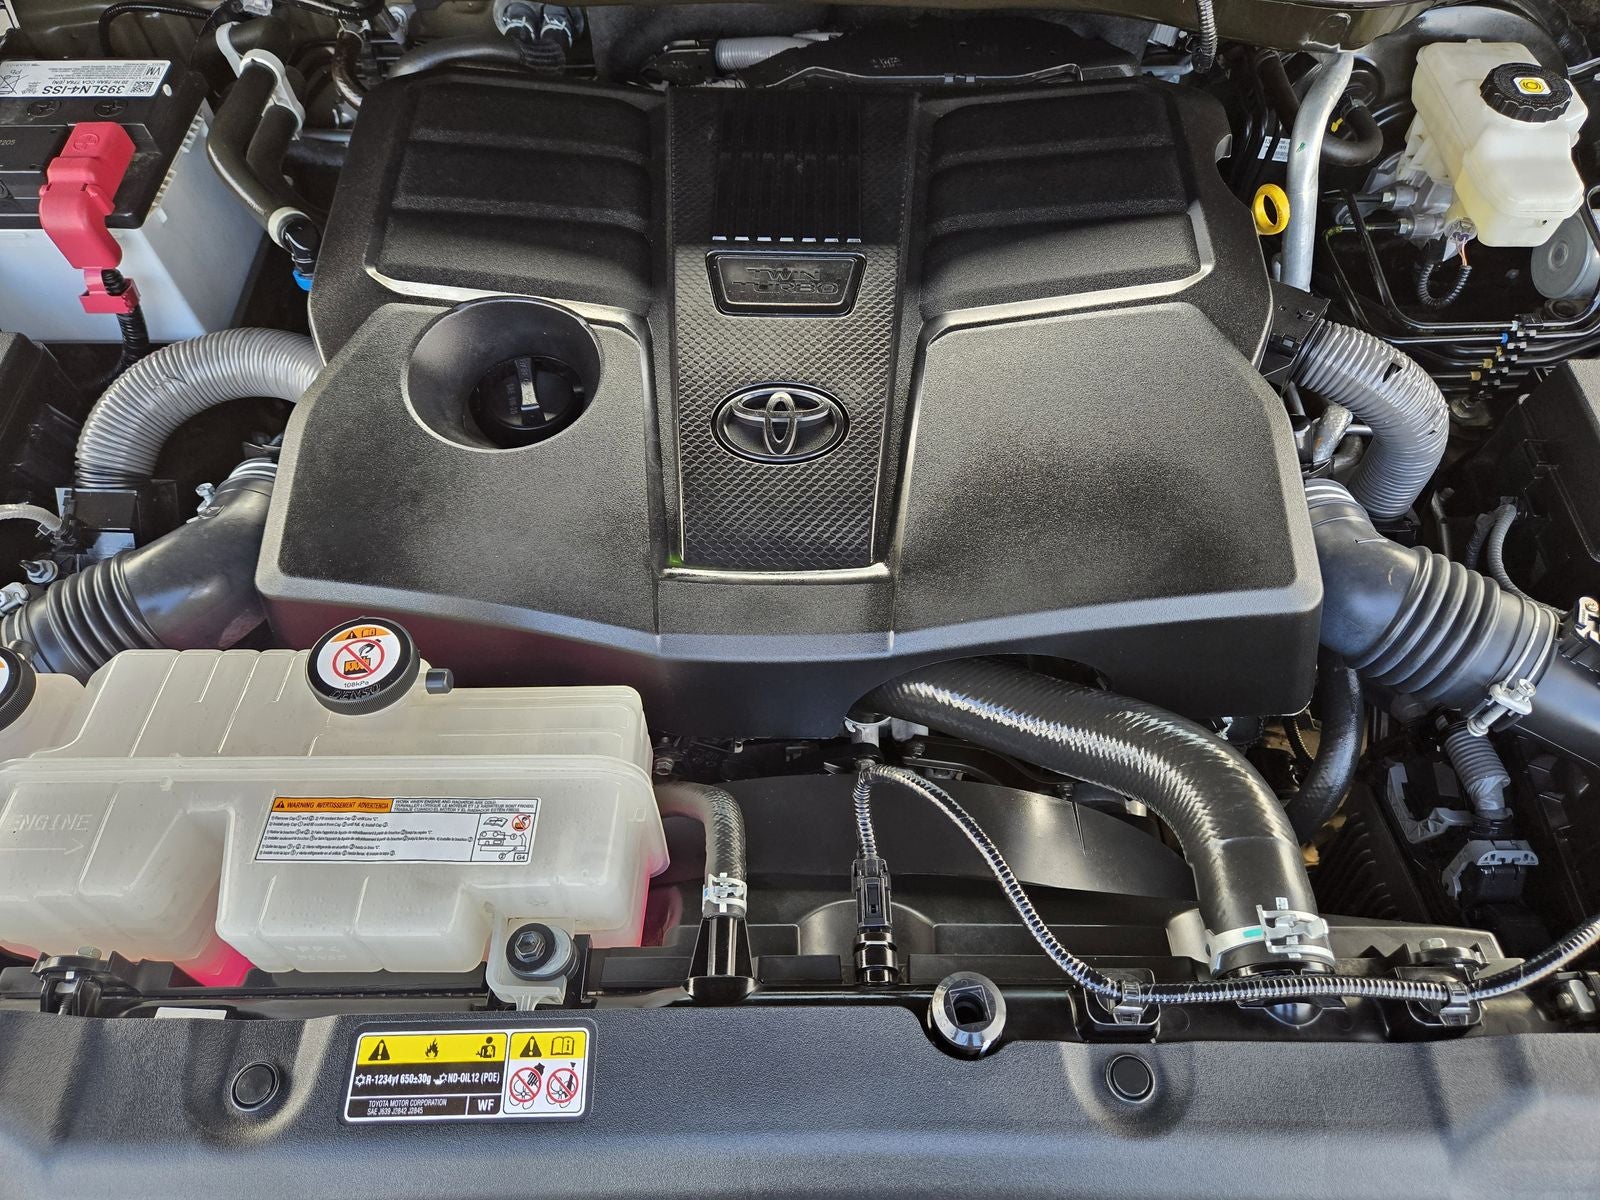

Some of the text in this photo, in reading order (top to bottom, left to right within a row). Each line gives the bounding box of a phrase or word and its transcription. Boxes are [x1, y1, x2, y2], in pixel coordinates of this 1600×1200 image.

[146, 67, 161, 76] VM
[41, 85, 126, 95] 395LN4-ISS
[746, 266, 822, 281] TWIN
[731, 281, 839, 295] TURBO
[343, 680, 370, 689] 108kPa
[329, 683, 381, 700] DENSO
[365, 1074, 399, 1086] R-1234yf
[400, 1073, 432, 1085] 650±30g
[480, 1072, 500, 1085] (POE)
[409, 1099, 448, 1107] CORPORATION
[477, 1099, 495, 1112] WF
[367, 1108, 378, 1116] SAE
